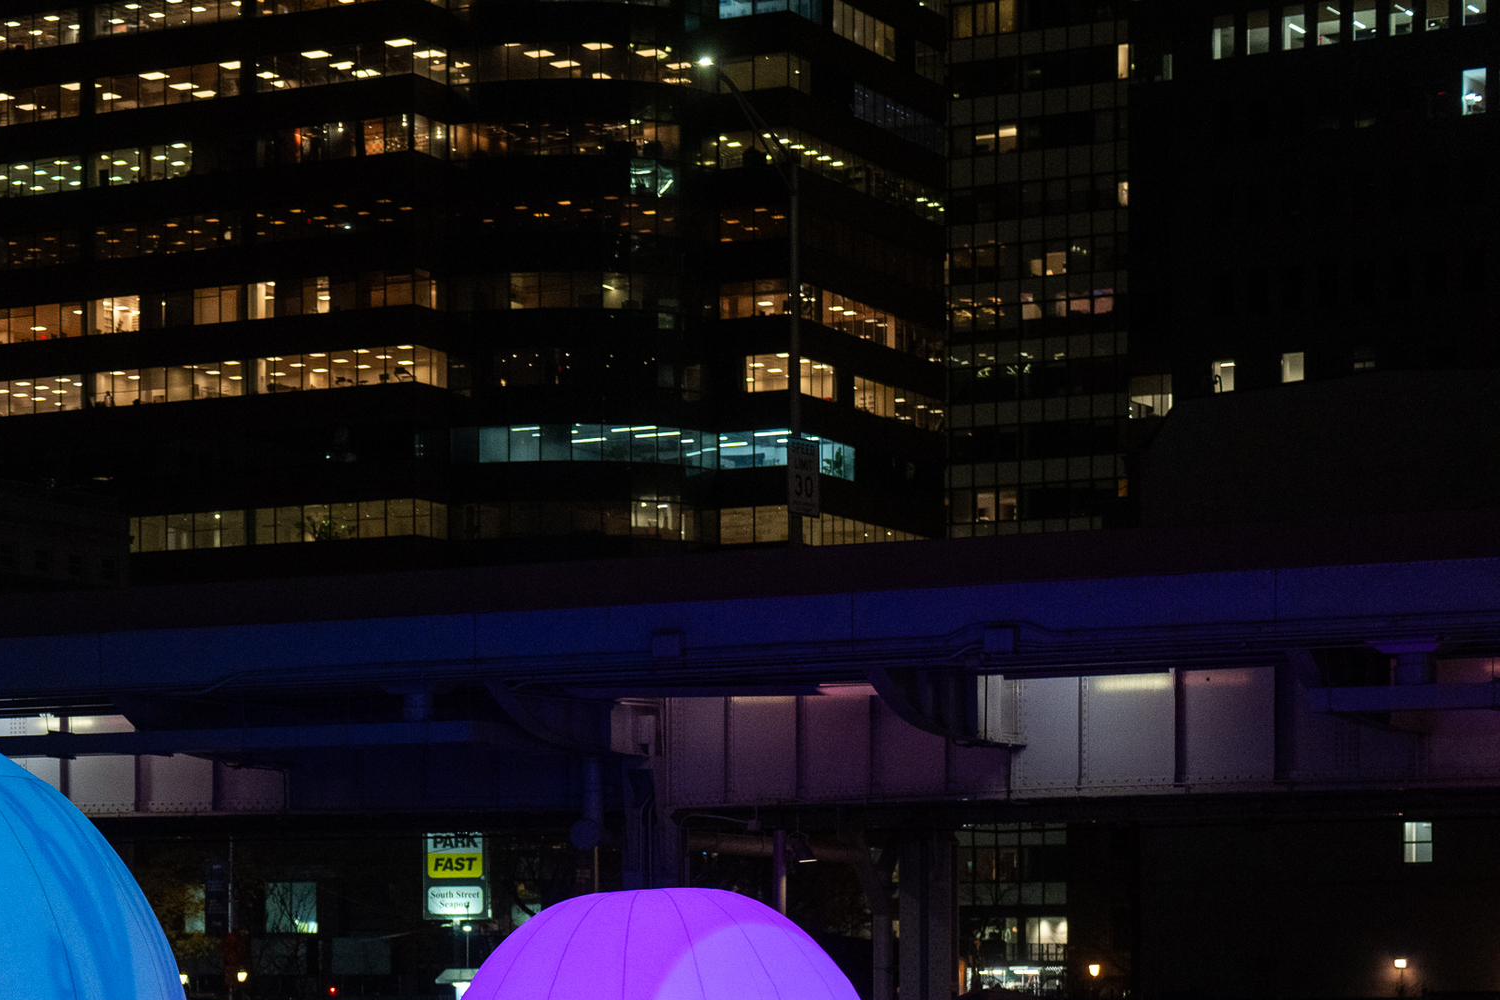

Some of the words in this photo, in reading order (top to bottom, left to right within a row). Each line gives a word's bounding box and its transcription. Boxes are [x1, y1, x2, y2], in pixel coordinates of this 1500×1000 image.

[791, 442, 815, 456] SPEED
[794, 459, 812, 471] LIMIT
[794, 474, 813, 498] 30
[433, 857, 477, 871] FAST
[430, 891, 454, 899] South
[456, 890, 480, 899] Street
